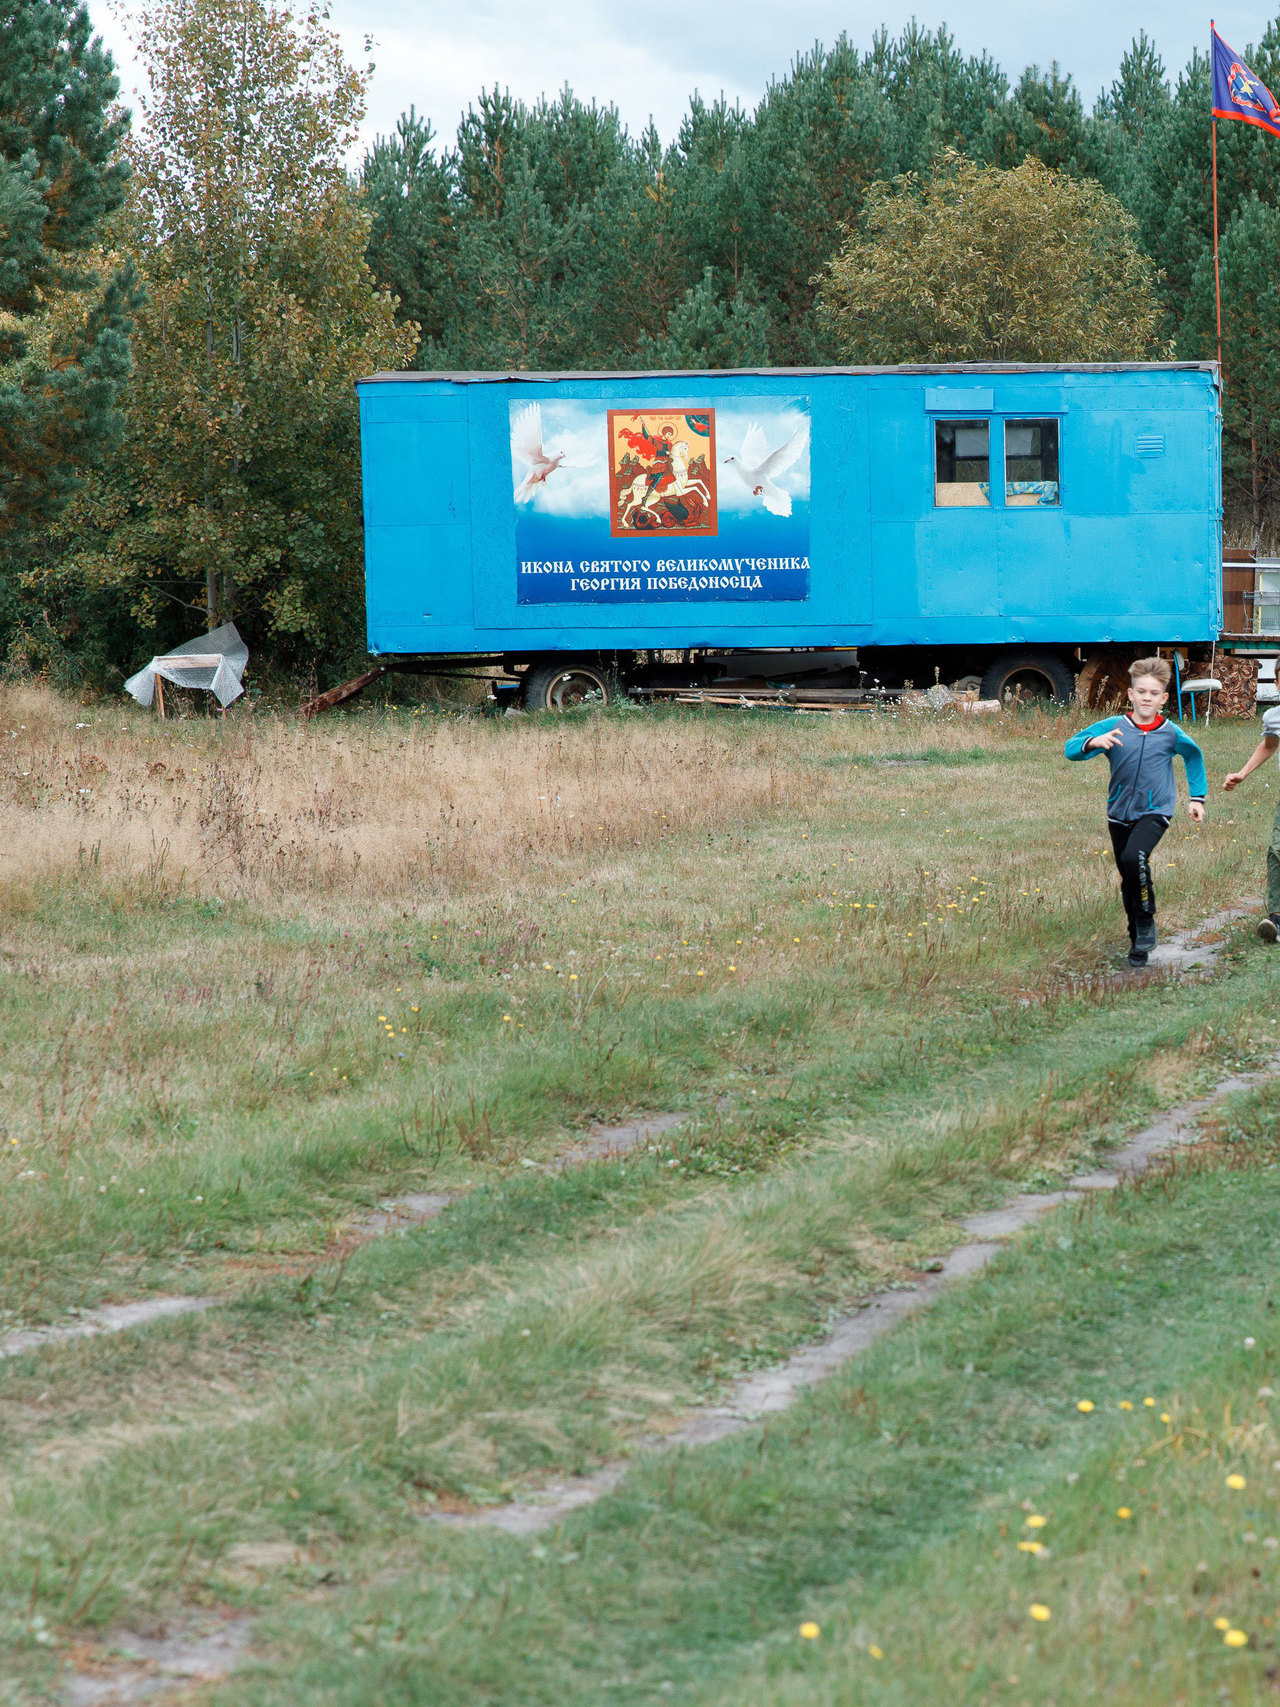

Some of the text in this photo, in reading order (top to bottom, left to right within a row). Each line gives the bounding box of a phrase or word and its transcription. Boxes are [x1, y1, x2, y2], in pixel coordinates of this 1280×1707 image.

[520, 556, 811, 574] ИКОНА СВЯТОГО ВЕЛИКОМУЧЕНИКА
[570, 575, 763, 592] ГЕОРГИЯ ПОБЕДОНОСЦА
